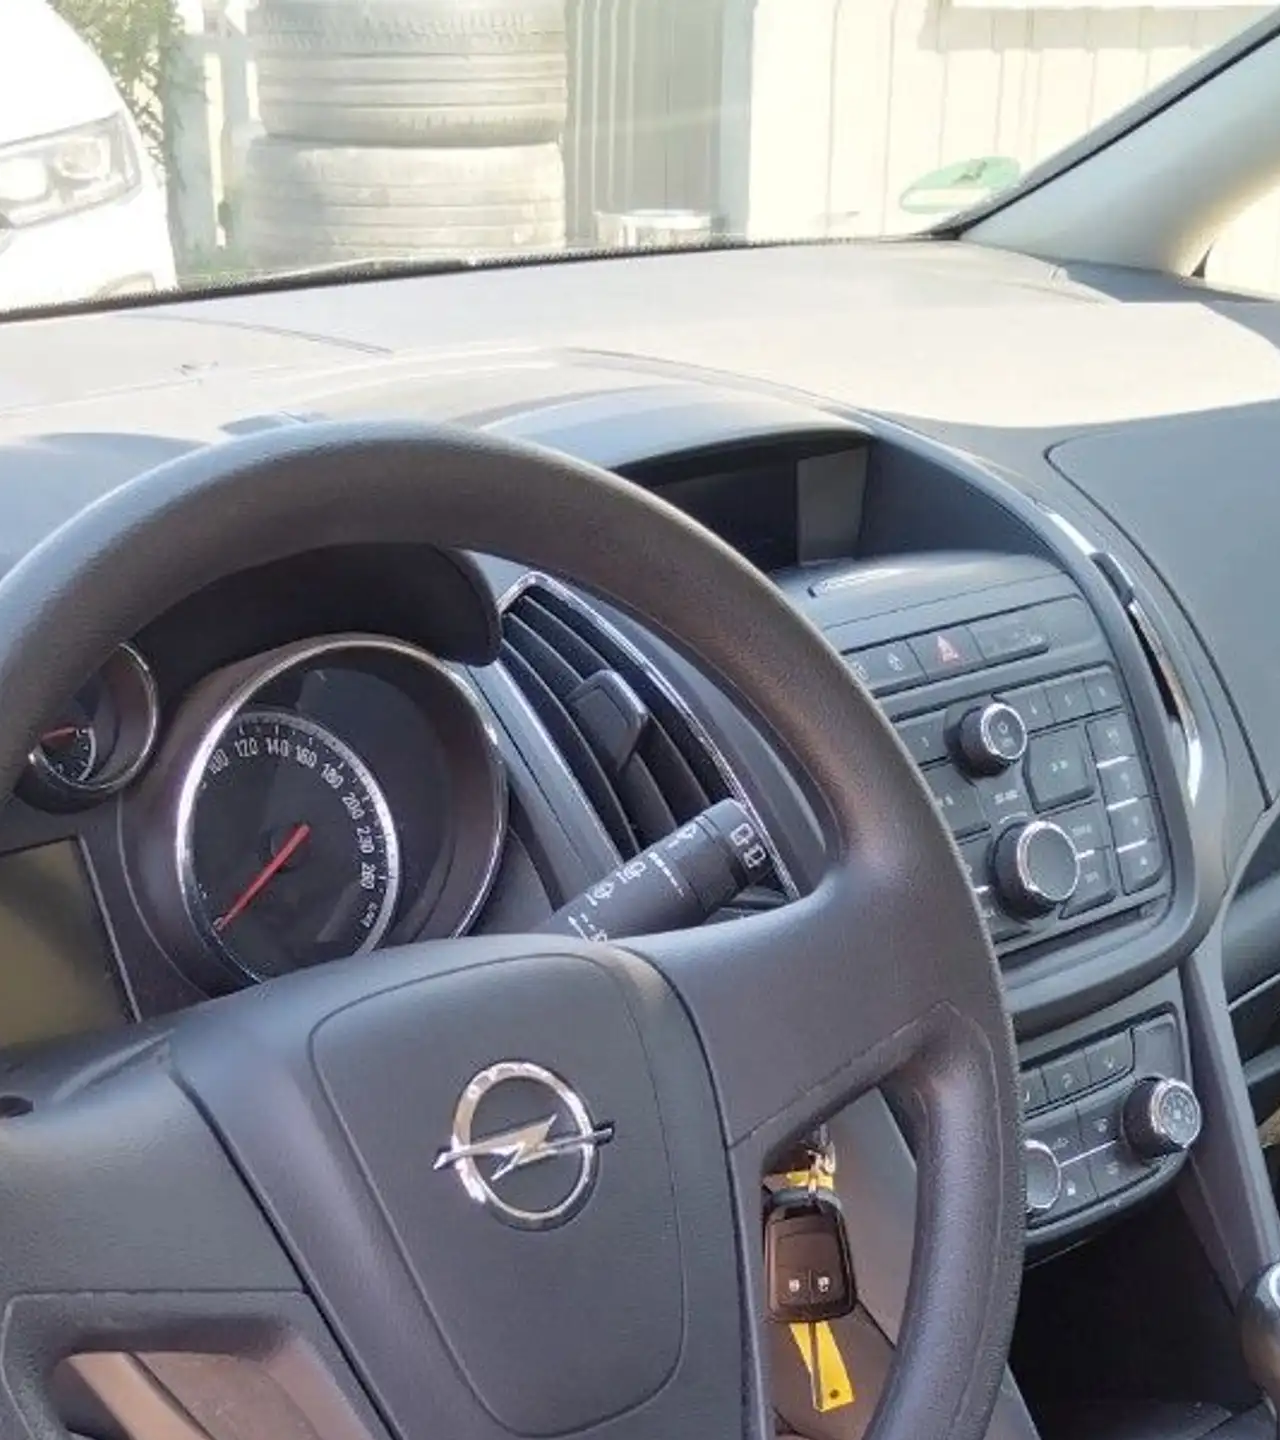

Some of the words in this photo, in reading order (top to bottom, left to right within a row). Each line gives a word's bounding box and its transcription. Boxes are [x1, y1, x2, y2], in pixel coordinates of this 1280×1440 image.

[234, 736, 260, 758] 120
[266, 736, 290, 758] 140
[295, 745, 318, 769] 160
[320, 762, 344, 790] 180
[342, 791, 366, 820] 200
